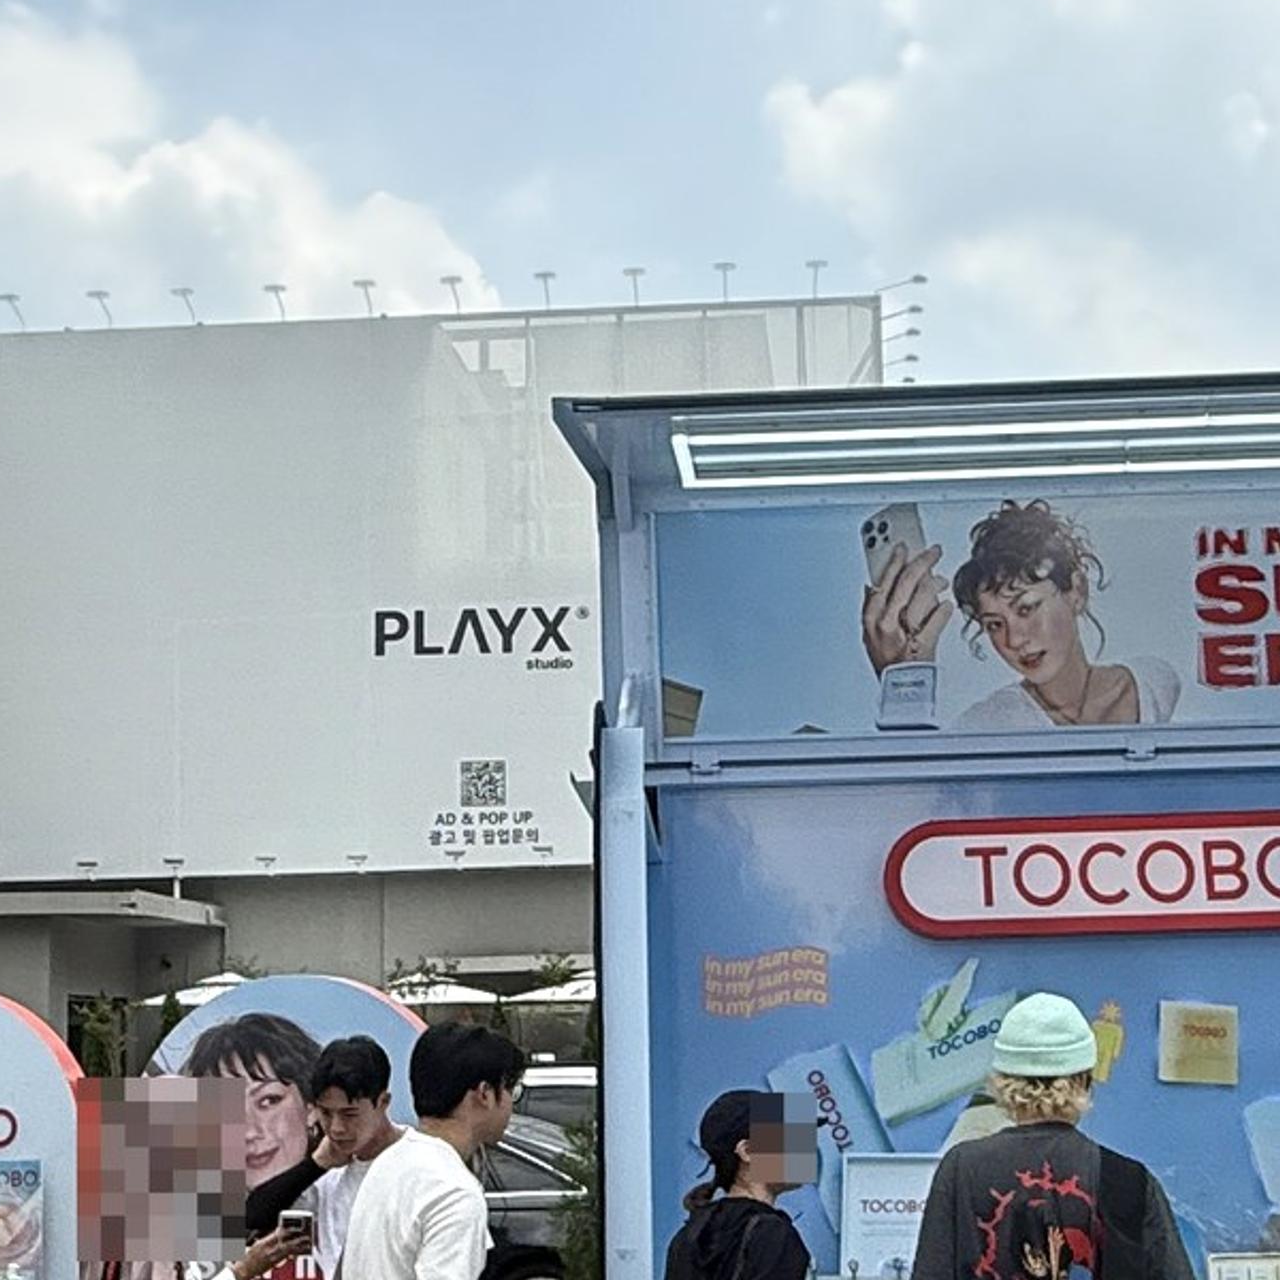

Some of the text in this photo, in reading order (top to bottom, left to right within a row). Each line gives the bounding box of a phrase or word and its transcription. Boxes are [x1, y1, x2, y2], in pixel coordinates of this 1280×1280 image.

[1198, 526, 1247, 559] IN
[526, 656, 574, 670] studio
[434, 810, 534, 826] AD & POP UP
[428, 828, 540, 846] 광고 및 팝업문의
[792, 948, 825, 965] era
[926, 1018, 1002, 1060] TOCOBO
